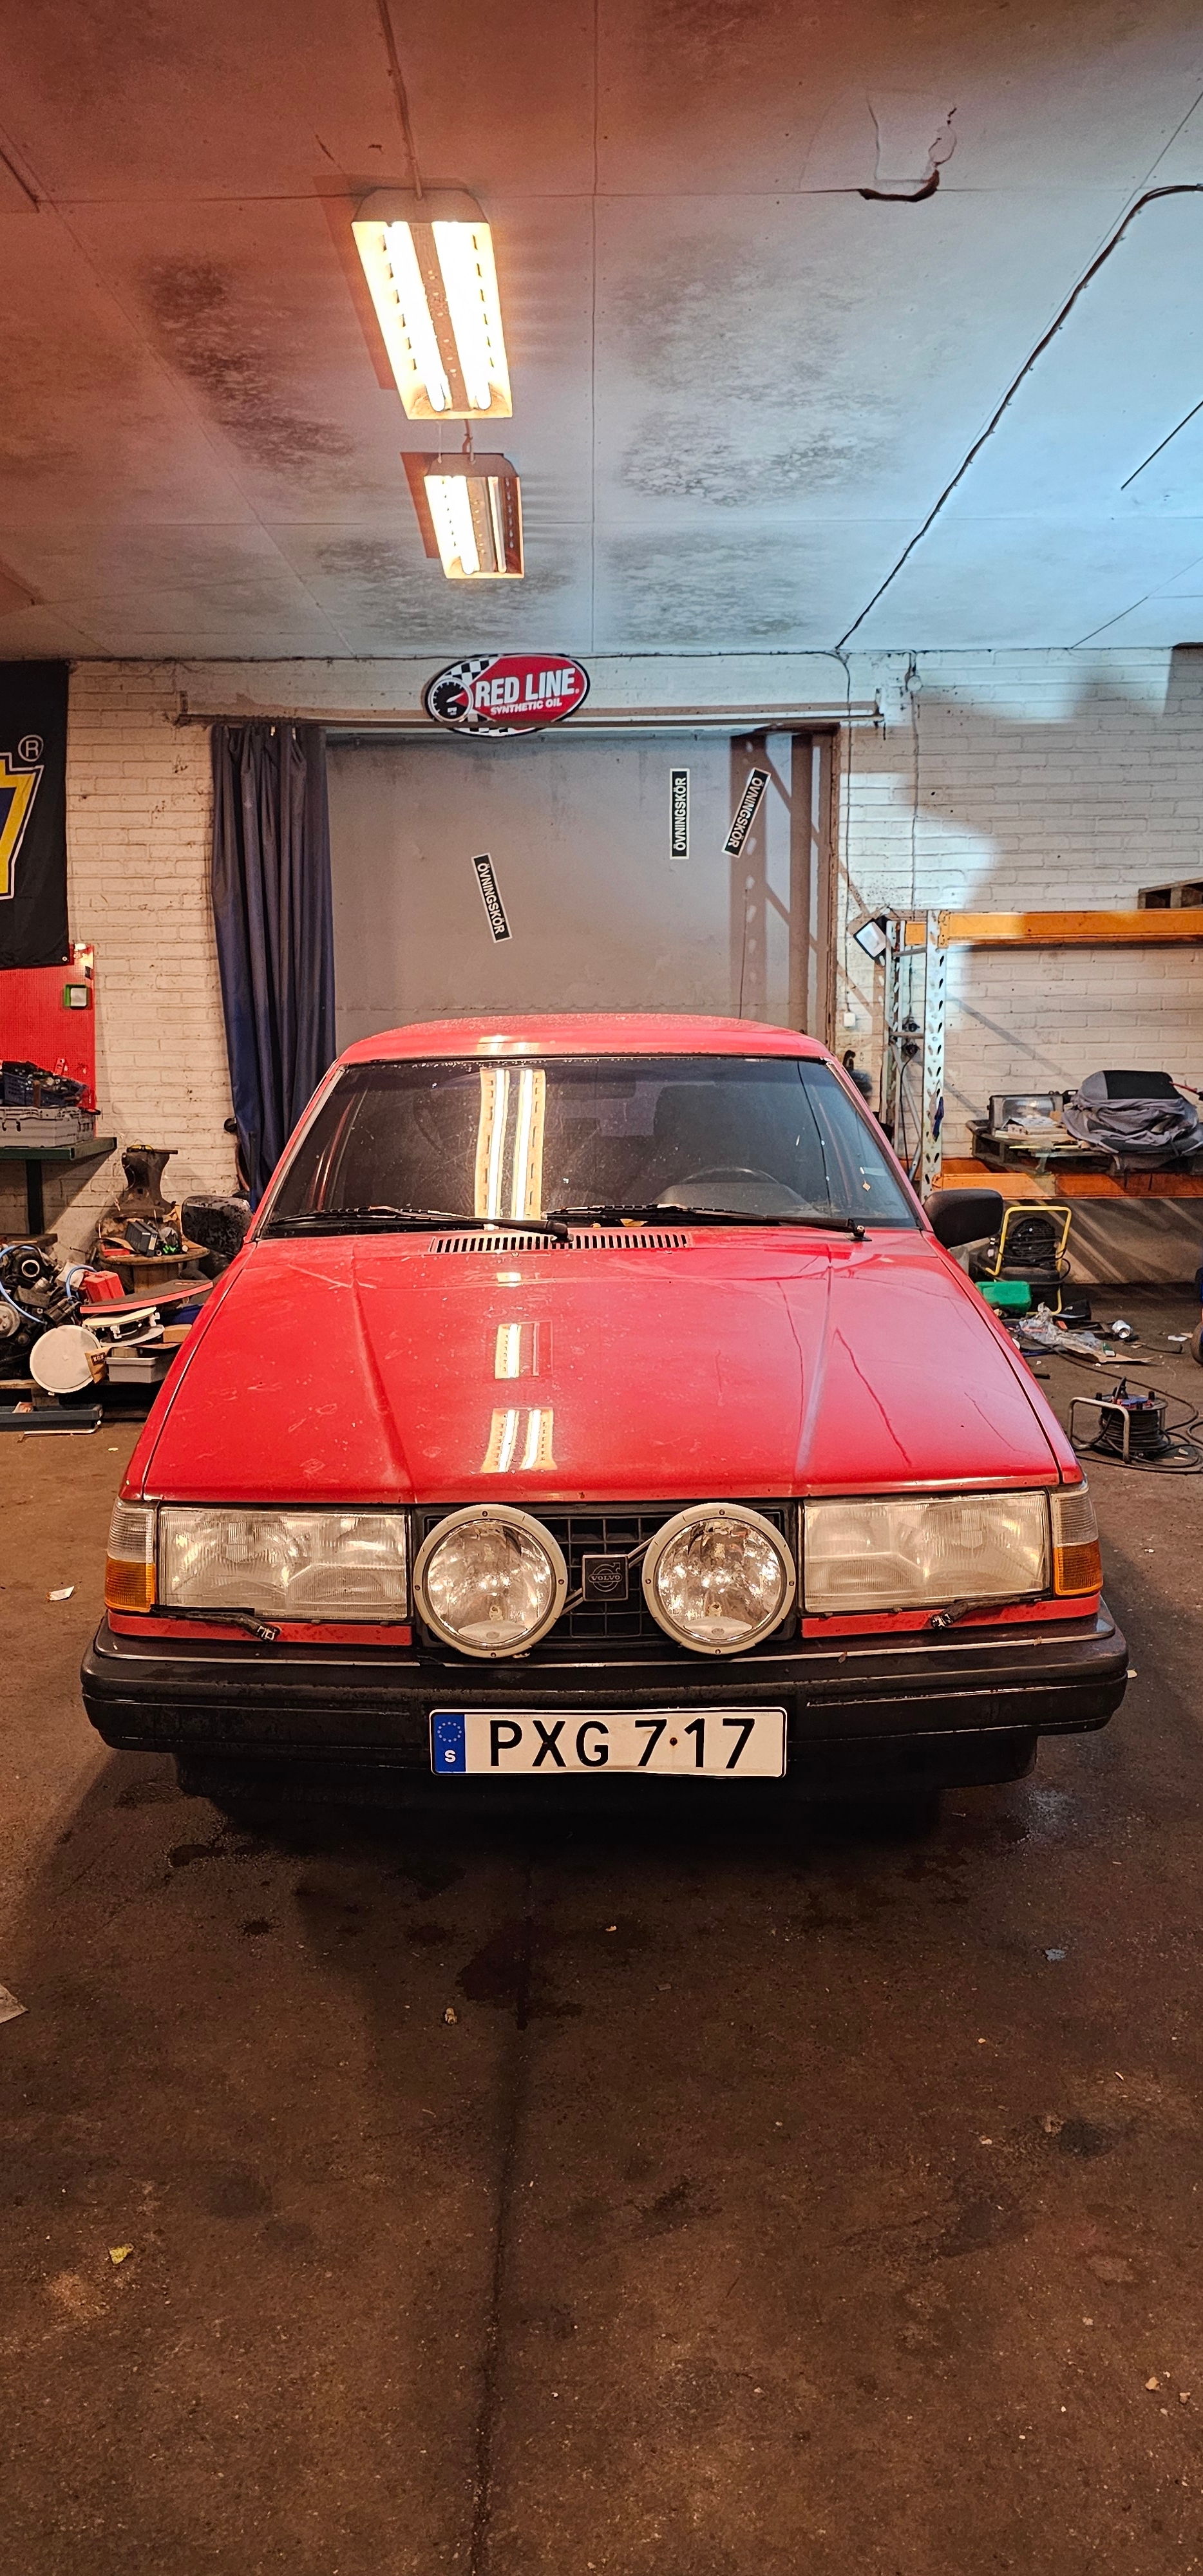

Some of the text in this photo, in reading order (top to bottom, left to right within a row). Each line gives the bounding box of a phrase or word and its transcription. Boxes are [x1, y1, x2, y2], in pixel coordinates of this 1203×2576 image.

[475, 677, 519, 708] RED
[490, 697, 562, 715] SYNTHETIC OIL
[673, 777, 686, 851] ÖVNINGSKÖR
[728, 777, 764, 848] ÖVNINGSKÖR
[477, 863, 505, 934] ÖVNINGSKÖR
[444, 1750, 456, 1763] S
[490, 1718, 755, 1769] PXG 717
